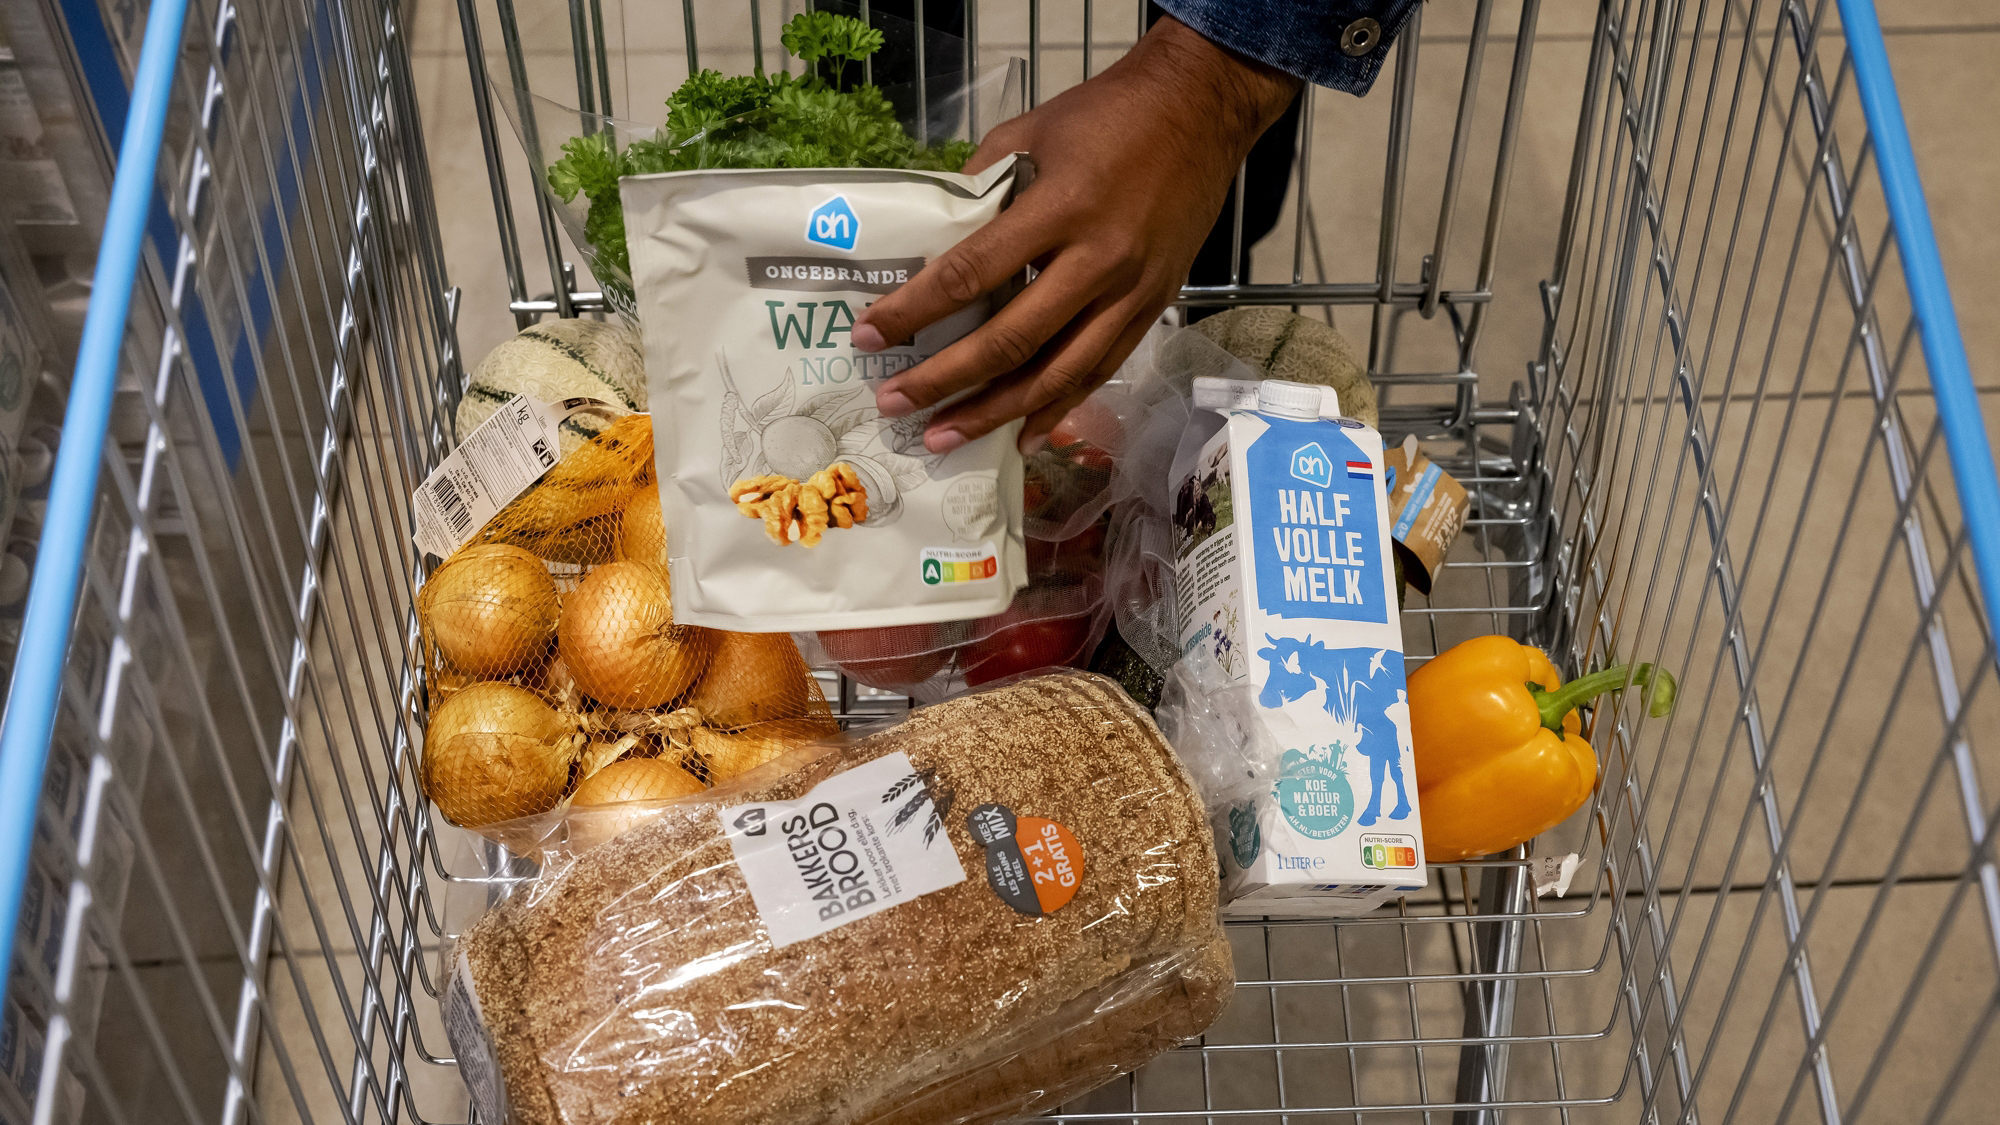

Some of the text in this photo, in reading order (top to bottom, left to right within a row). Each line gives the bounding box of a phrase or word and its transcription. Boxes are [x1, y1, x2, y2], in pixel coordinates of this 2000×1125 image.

[765, 265, 908, 284] ONGEBRANDE
[511, 395, 530, 426] 1 kg
[538, 415, 548, 430] Uien
[1278, 489, 1350, 526] HALF
[1433, 506, 1458, 548] ZAKJE
[926, 550, 982, 559] NUTRI-SCORE
[1273, 527, 1364, 567] VOLLE
[925, 563, 939, 579] A
[1283, 566, 1363, 605] MELK
[1318, 766, 1337, 781] VOOR
[1305, 780, 1327, 791] KOE
[1293, 792, 1340, 804] NATUUR
[1298, 805, 1338, 816] & BOER
[974, 813, 995, 843] KIES &
[982, 806, 1011, 840] MIX
[1288, 814, 1349, 838] AH.NL/BETERETEN
[856, 829, 868, 846] elke
[809, 802, 877, 911] BROOD
[864, 847, 878, 867] voor
[872, 836, 894, 874] krokante
[1024, 840, 1055, 884] 2+1
[1041, 824, 1076, 887] GRATIS
[1278, 853, 1283, 869] 1
[1286, 855, 1311, 869] LITER
[1376, 849, 1384, 862] B
[1397, 852, 1404, 861] D
[1407, 852, 1413, 861] E
[782, 815, 845, 921] BAKKERS
[992, 865, 1007, 886] ALLE
[997, 851, 1021, 896] LES PAINS
[1011, 858, 1025, 881] HEEL
[874, 868, 892, 898] Lekker
[889, 874, 902, 893] met
